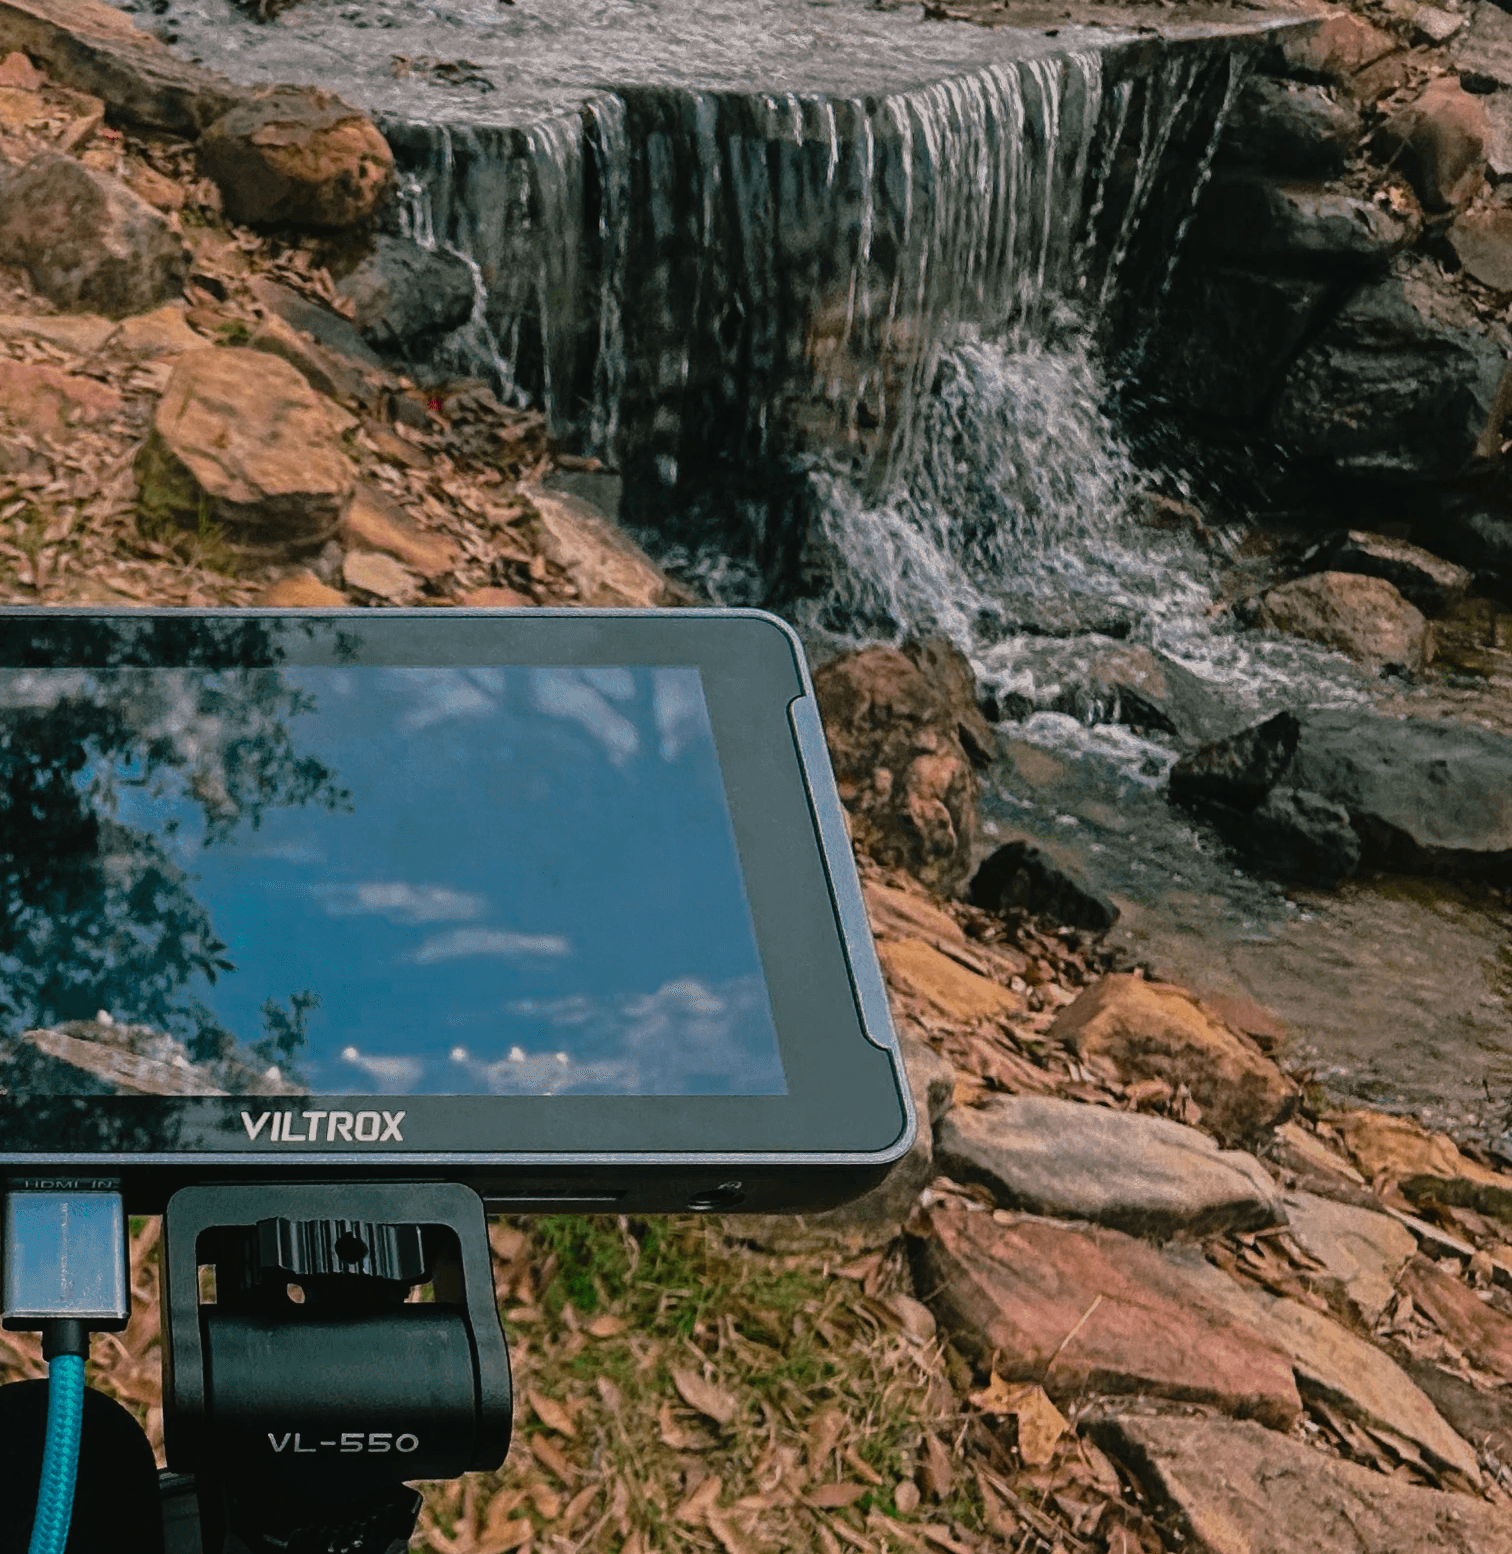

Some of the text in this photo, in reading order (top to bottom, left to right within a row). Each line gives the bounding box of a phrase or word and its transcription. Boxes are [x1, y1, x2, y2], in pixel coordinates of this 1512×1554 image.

[240, 1111, 406, 1142] VILTROX
[24, 1179, 82, 1189] HDMI
[267, 1432, 419, 1453] VL-550
